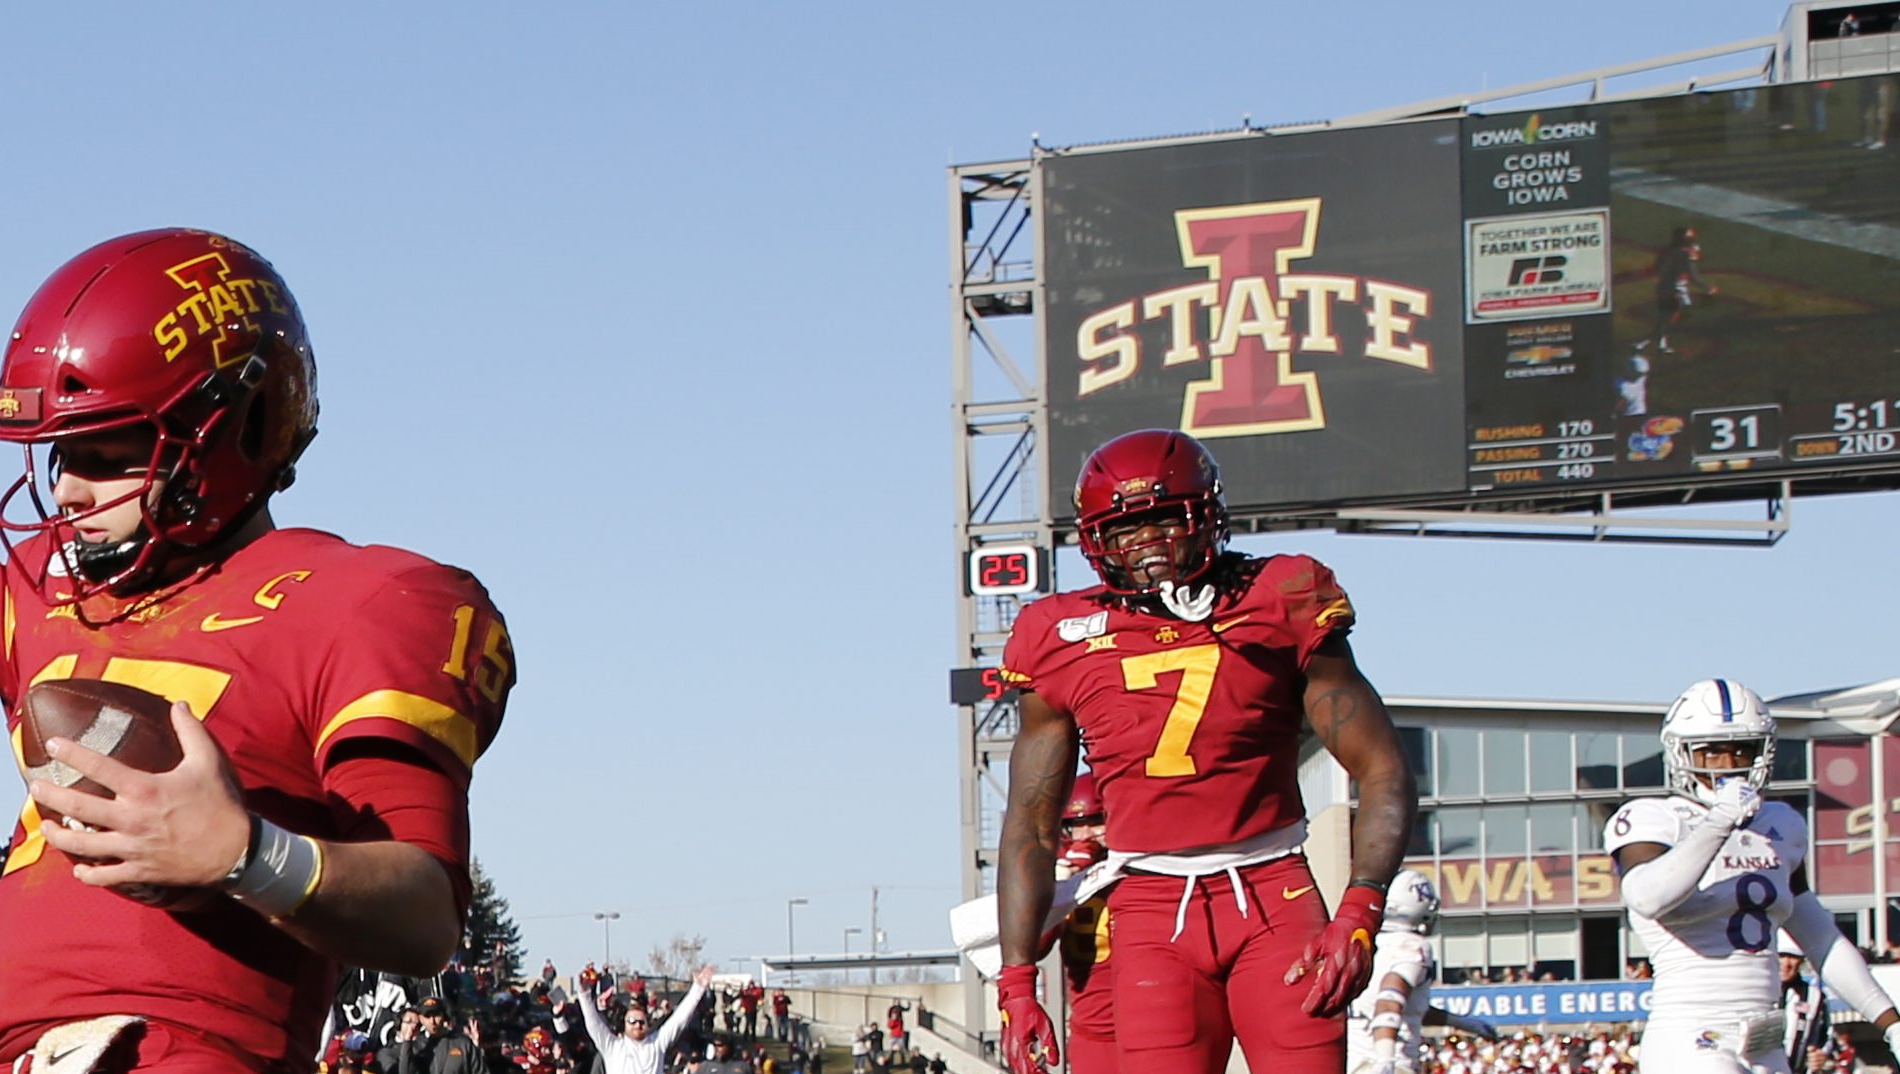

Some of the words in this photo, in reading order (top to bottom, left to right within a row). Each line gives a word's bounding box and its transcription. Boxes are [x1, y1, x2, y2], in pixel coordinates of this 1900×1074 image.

[1472, 127, 1526, 148] IOWA
[1538, 120, 1598, 141] CORN
[1504, 151, 1571, 171] CORN
[1493, 166, 1583, 189] GROWS
[1508, 186, 1568, 205] IOWA
[1550, 224, 1572, 236] WE
[1574, 222, 1599, 233] ARE
[1480, 240, 1527, 257] FARM
[1531, 234, 1600, 252] STRONG
[153, 279, 289, 363] STATE
[1077, 276, 1432, 397] STATE
[1475, 424, 1544, 440] RUSHING
[1558, 420, 1594, 437] 170
[1833, 400, 1900, 432] 5:1
[1710, 415, 1759, 451] 31
[1838, 432, 1896, 455] 2ND
[1475, 446, 1541, 462] PASSING
[1557, 443, 1594, 460] 270
[1494, 469, 1543, 483] TOTAL
[1557, 463, 1594, 480] 440
[982, 553, 1027, 587] 25
[254, 570, 314, 610] C
[442, 605, 513, 703] 15
[1121, 643, 1222, 778] 7
[1614, 809, 1632, 838] 8
[1722, 855, 1781, 871] KANSAS
[1726, 872, 1778, 954] 8
